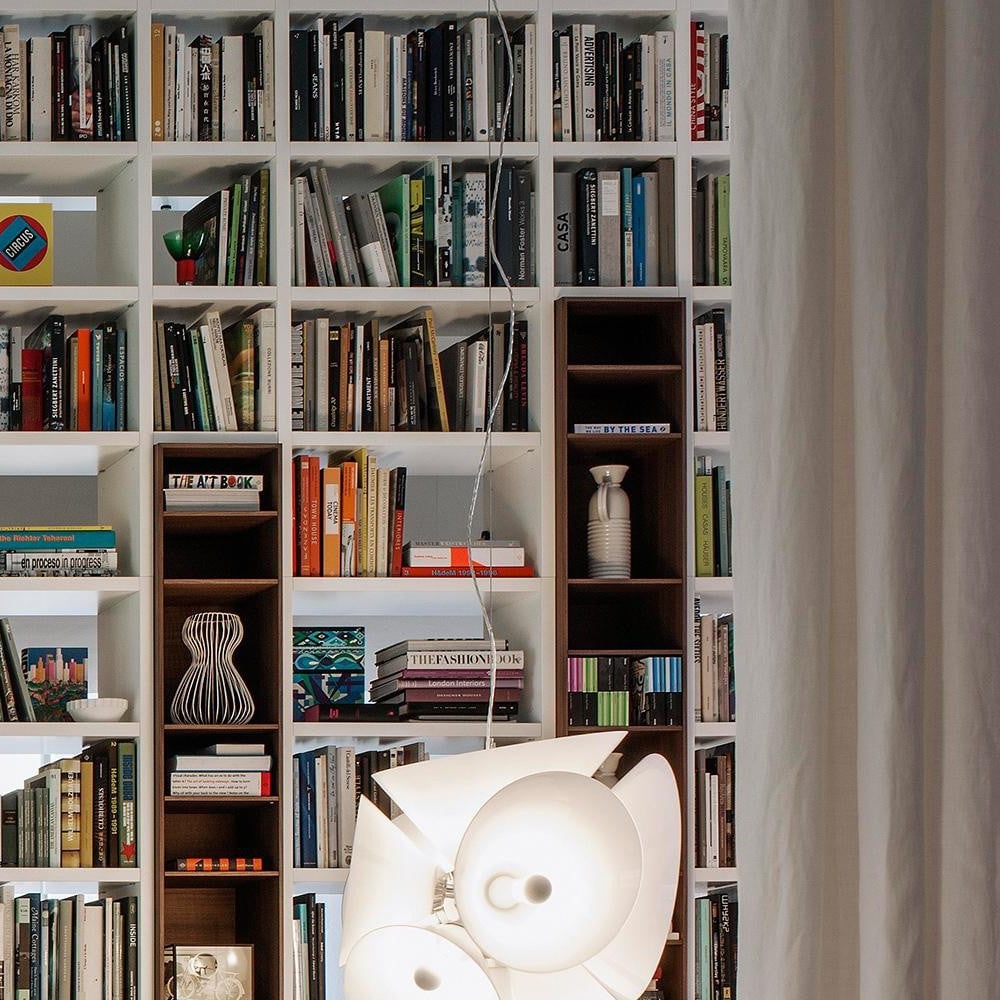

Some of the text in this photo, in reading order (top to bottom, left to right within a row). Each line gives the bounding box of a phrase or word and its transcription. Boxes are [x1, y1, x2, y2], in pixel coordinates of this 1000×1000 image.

[4, 42, 11, 50] LA
[12, 53, 20, 114] HAR KARKOM
[584, 36, 595, 119] ADVERTISING 29
[666, 80, 672, 88] IN
[5, 101, 13, 110] DI
[518, 206, 526, 225] Works
[5, 230, 34, 258] CIRCUS
[518, 228, 526, 250] Foster
[556, 213, 569, 252] CASA
[518, 252, 526, 280] Norman
[173, 475, 253, 489] THE ART BOOK
[699, 483, 708, 536] HOUSES CASAS
[21, 556, 102, 570] en proceso in progress
[30, 907, 39, 963] Maine Cottages
